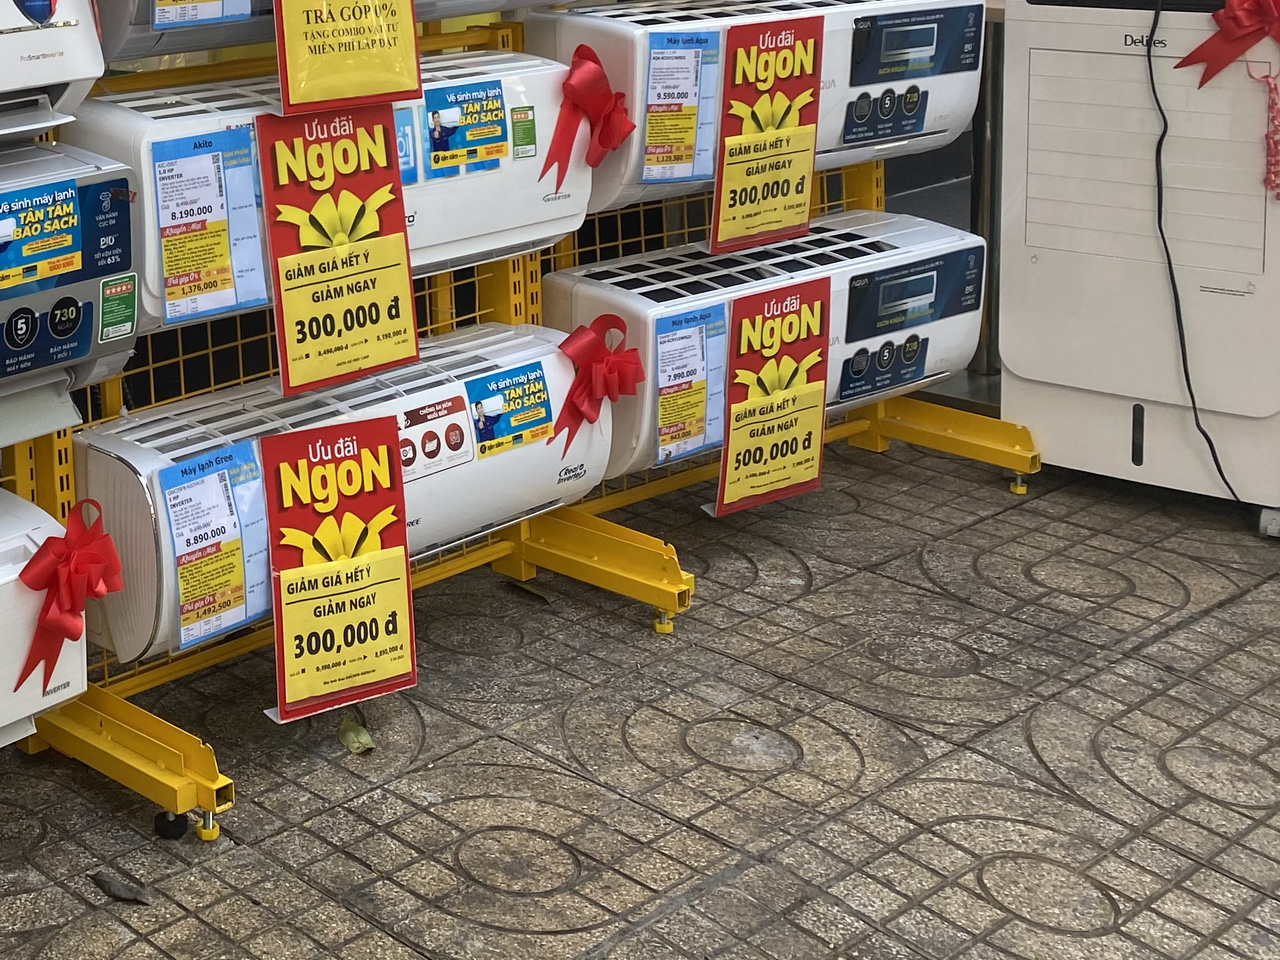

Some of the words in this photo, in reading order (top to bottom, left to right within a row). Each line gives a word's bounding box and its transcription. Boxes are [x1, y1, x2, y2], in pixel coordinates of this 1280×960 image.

[1124, 34, 1167, 49] Delies
[657, 91, 689, 100] 9.590.000
[193, 140, 213, 150] Akito
[728, 178, 790, 208] 300,000
[171, 205, 213, 220] 8.190.000
[181, 280, 218, 295] 1,376,000
[54, 306, 77, 323] 730
[295, 302, 380, 344] 300,000
[668, 369, 697, 383] 7.990.000
[215, 454, 233, 466] Gree
[734, 438, 799, 471] 500,000
[186, 526, 226, 547] 8.890.000
[196, 599, 231, 619] 1,492,500
[294, 618, 379, 659] 300,000
